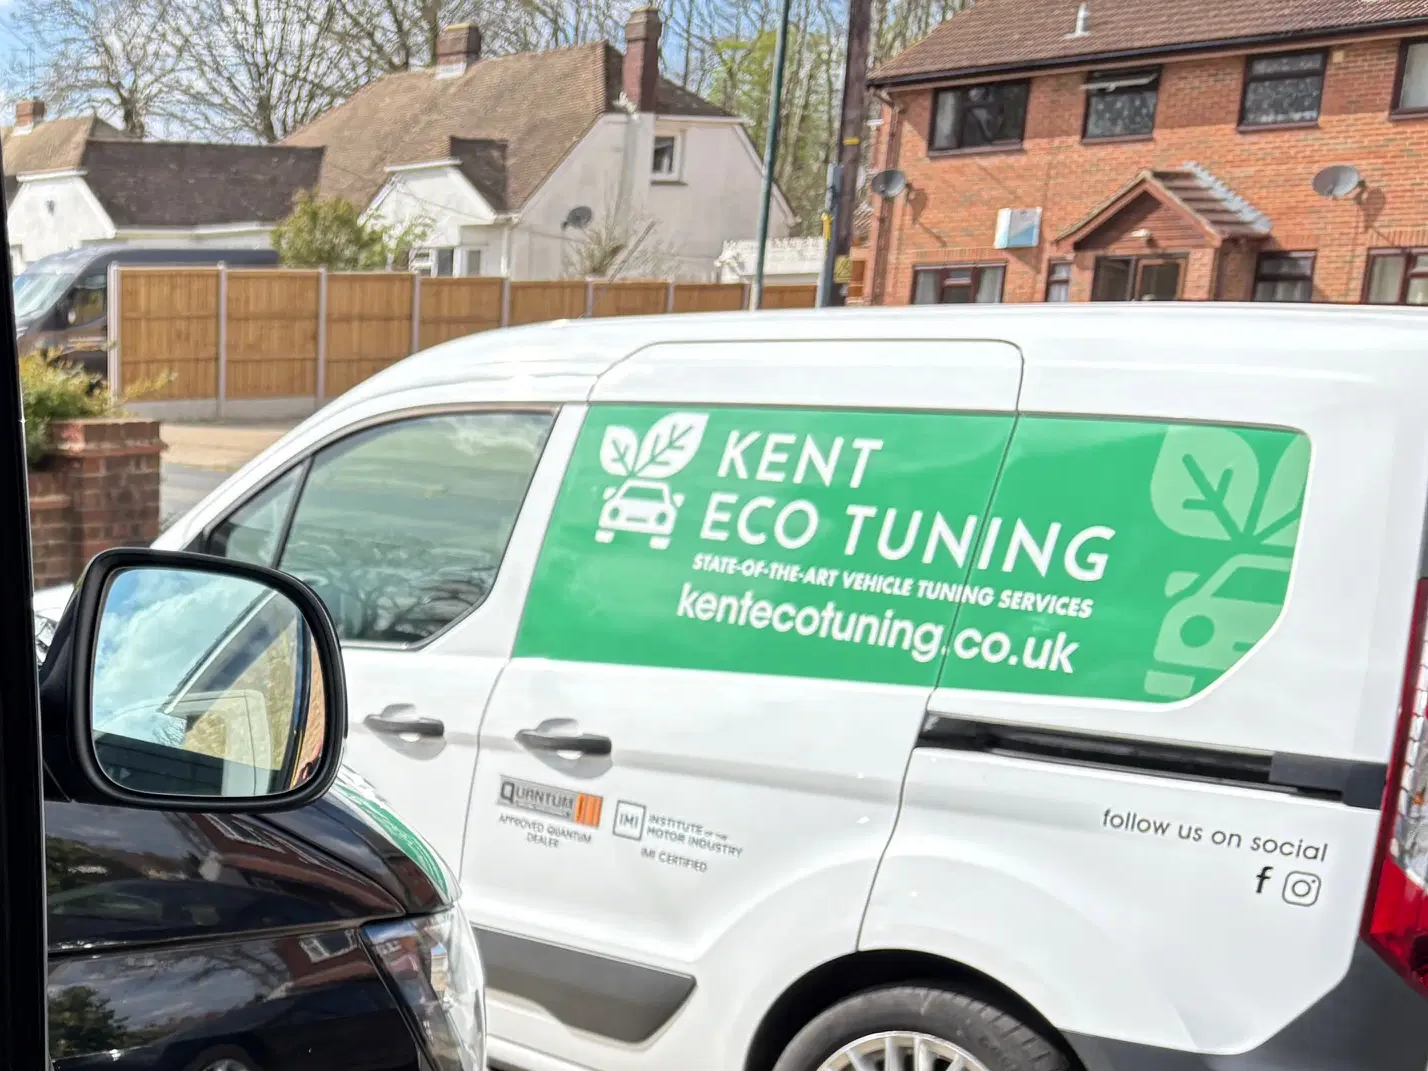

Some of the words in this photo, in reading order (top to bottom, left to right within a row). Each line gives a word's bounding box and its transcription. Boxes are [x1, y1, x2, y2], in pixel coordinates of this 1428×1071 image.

[717, 429, 884, 488] KENT
[700, 491, 819, 549] ECO
[844, 504, 1116, 582] TUNING
[692, 552, 839, 587] STATE-OF-THE-ART
[842, 570, 914, 597] VEHICLE
[917, 579, 994, 606] TUNING
[998, 589, 1094, 619] SERVICES
[676, 581, 1080, 673] kentecotuning.co.uk
[500, 781, 574, 809] QUANTUM
[547, 825, 592, 843] QUANTUM
[619, 813, 639, 828] IMI
[649, 814, 704, 833] INSTITUTE
[1102, 808, 1170, 836] follow
[1178, 823, 1203, 842] us
[1211, 830, 1242, 848] on
[1250, 836, 1329, 862] social
[647, 827, 686, 843] MOTOR
[688, 836, 743, 858] INDUSTRY
[659, 850, 707, 873] CERTIFIED
